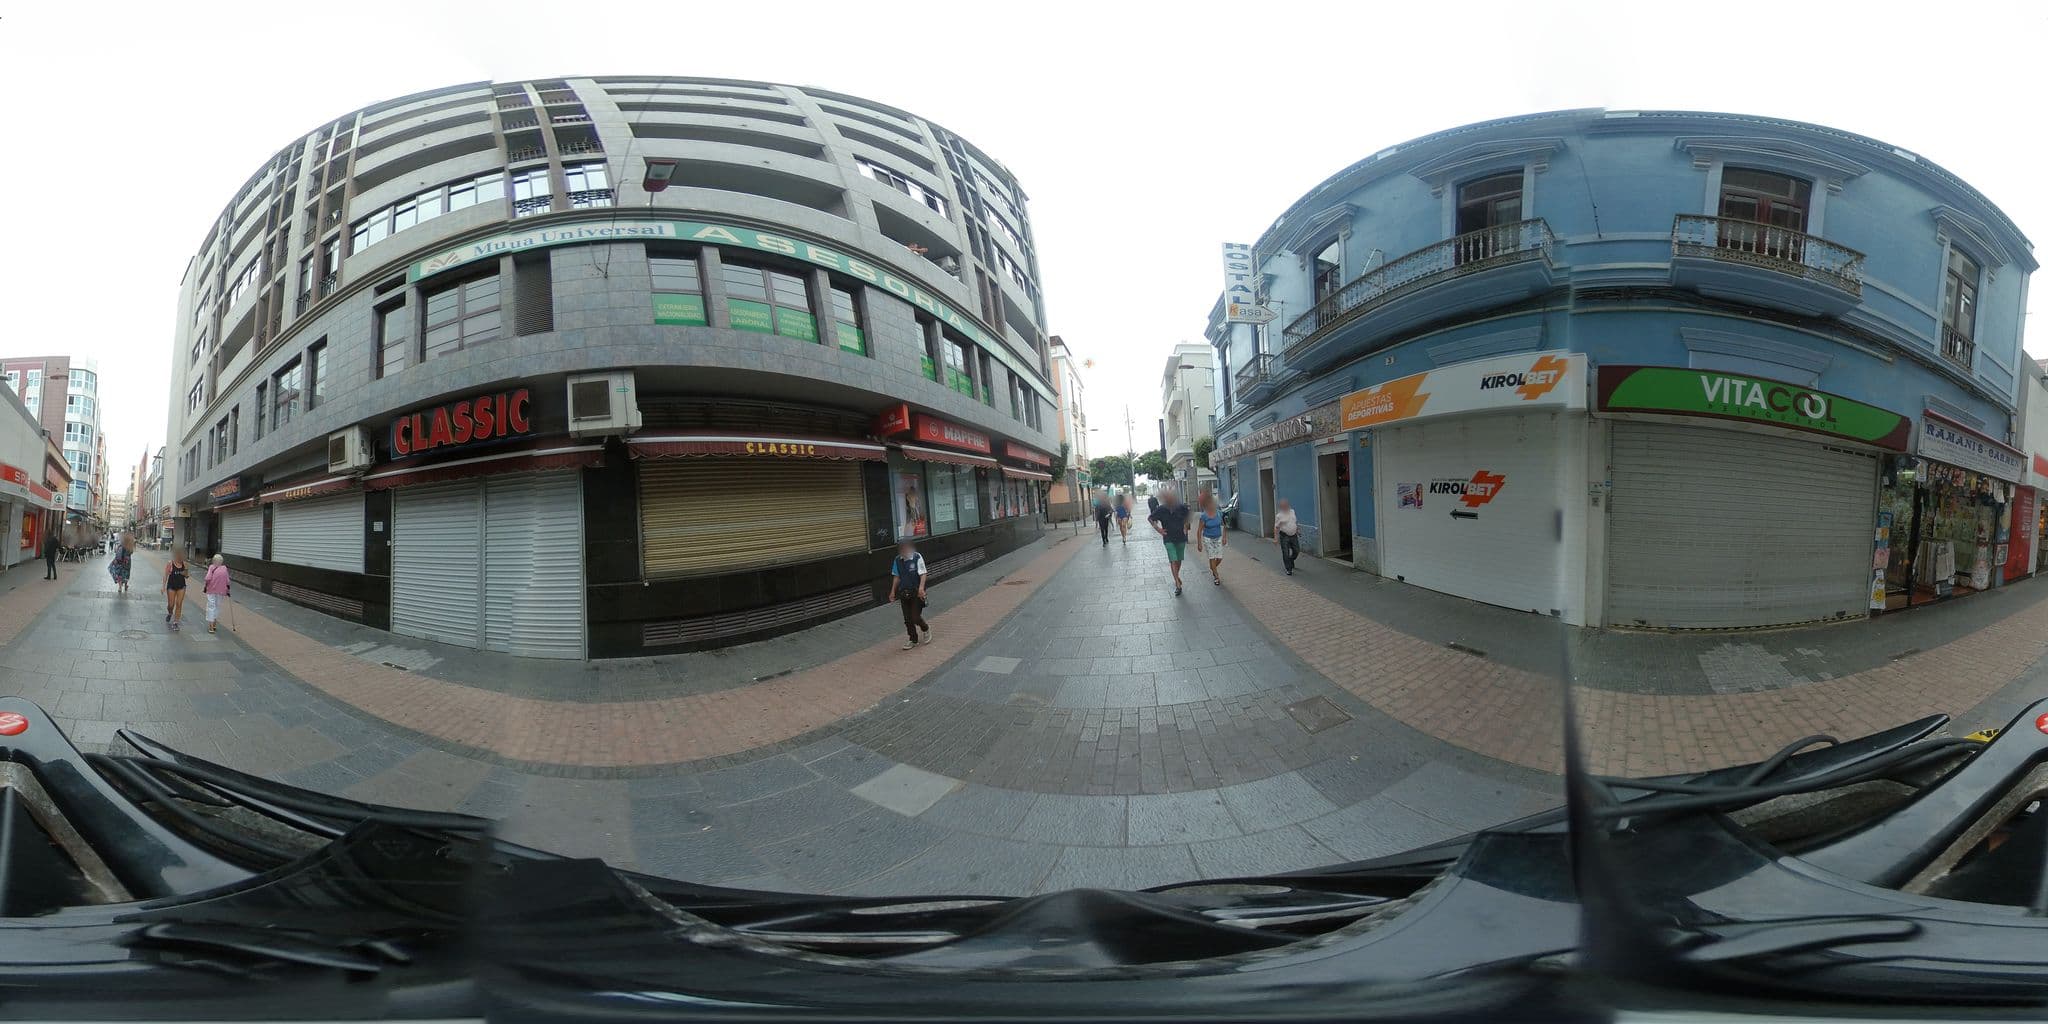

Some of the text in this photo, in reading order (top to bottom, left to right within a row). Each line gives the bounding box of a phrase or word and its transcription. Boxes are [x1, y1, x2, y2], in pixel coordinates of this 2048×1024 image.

[541, 224, 664, 243] Universal
[693, 226, 965, 330] ASESORIA
[1225, 242, 1251, 305] HOSTAL
[1480, 369, 1557, 390] KIROLBET
[1351, 392, 1392, 411] APUESTAS
[1700, 375, 1839, 423] VITACOOL
[394, 388, 529, 455] CLASSIC
[1347, 402, 1394, 422] DEPORTIVAS
[944, 426, 985, 448] MAPFRE
[746, 442, 815, 455] CLASSIC
[1429, 481, 1496, 496] KIROLBET
